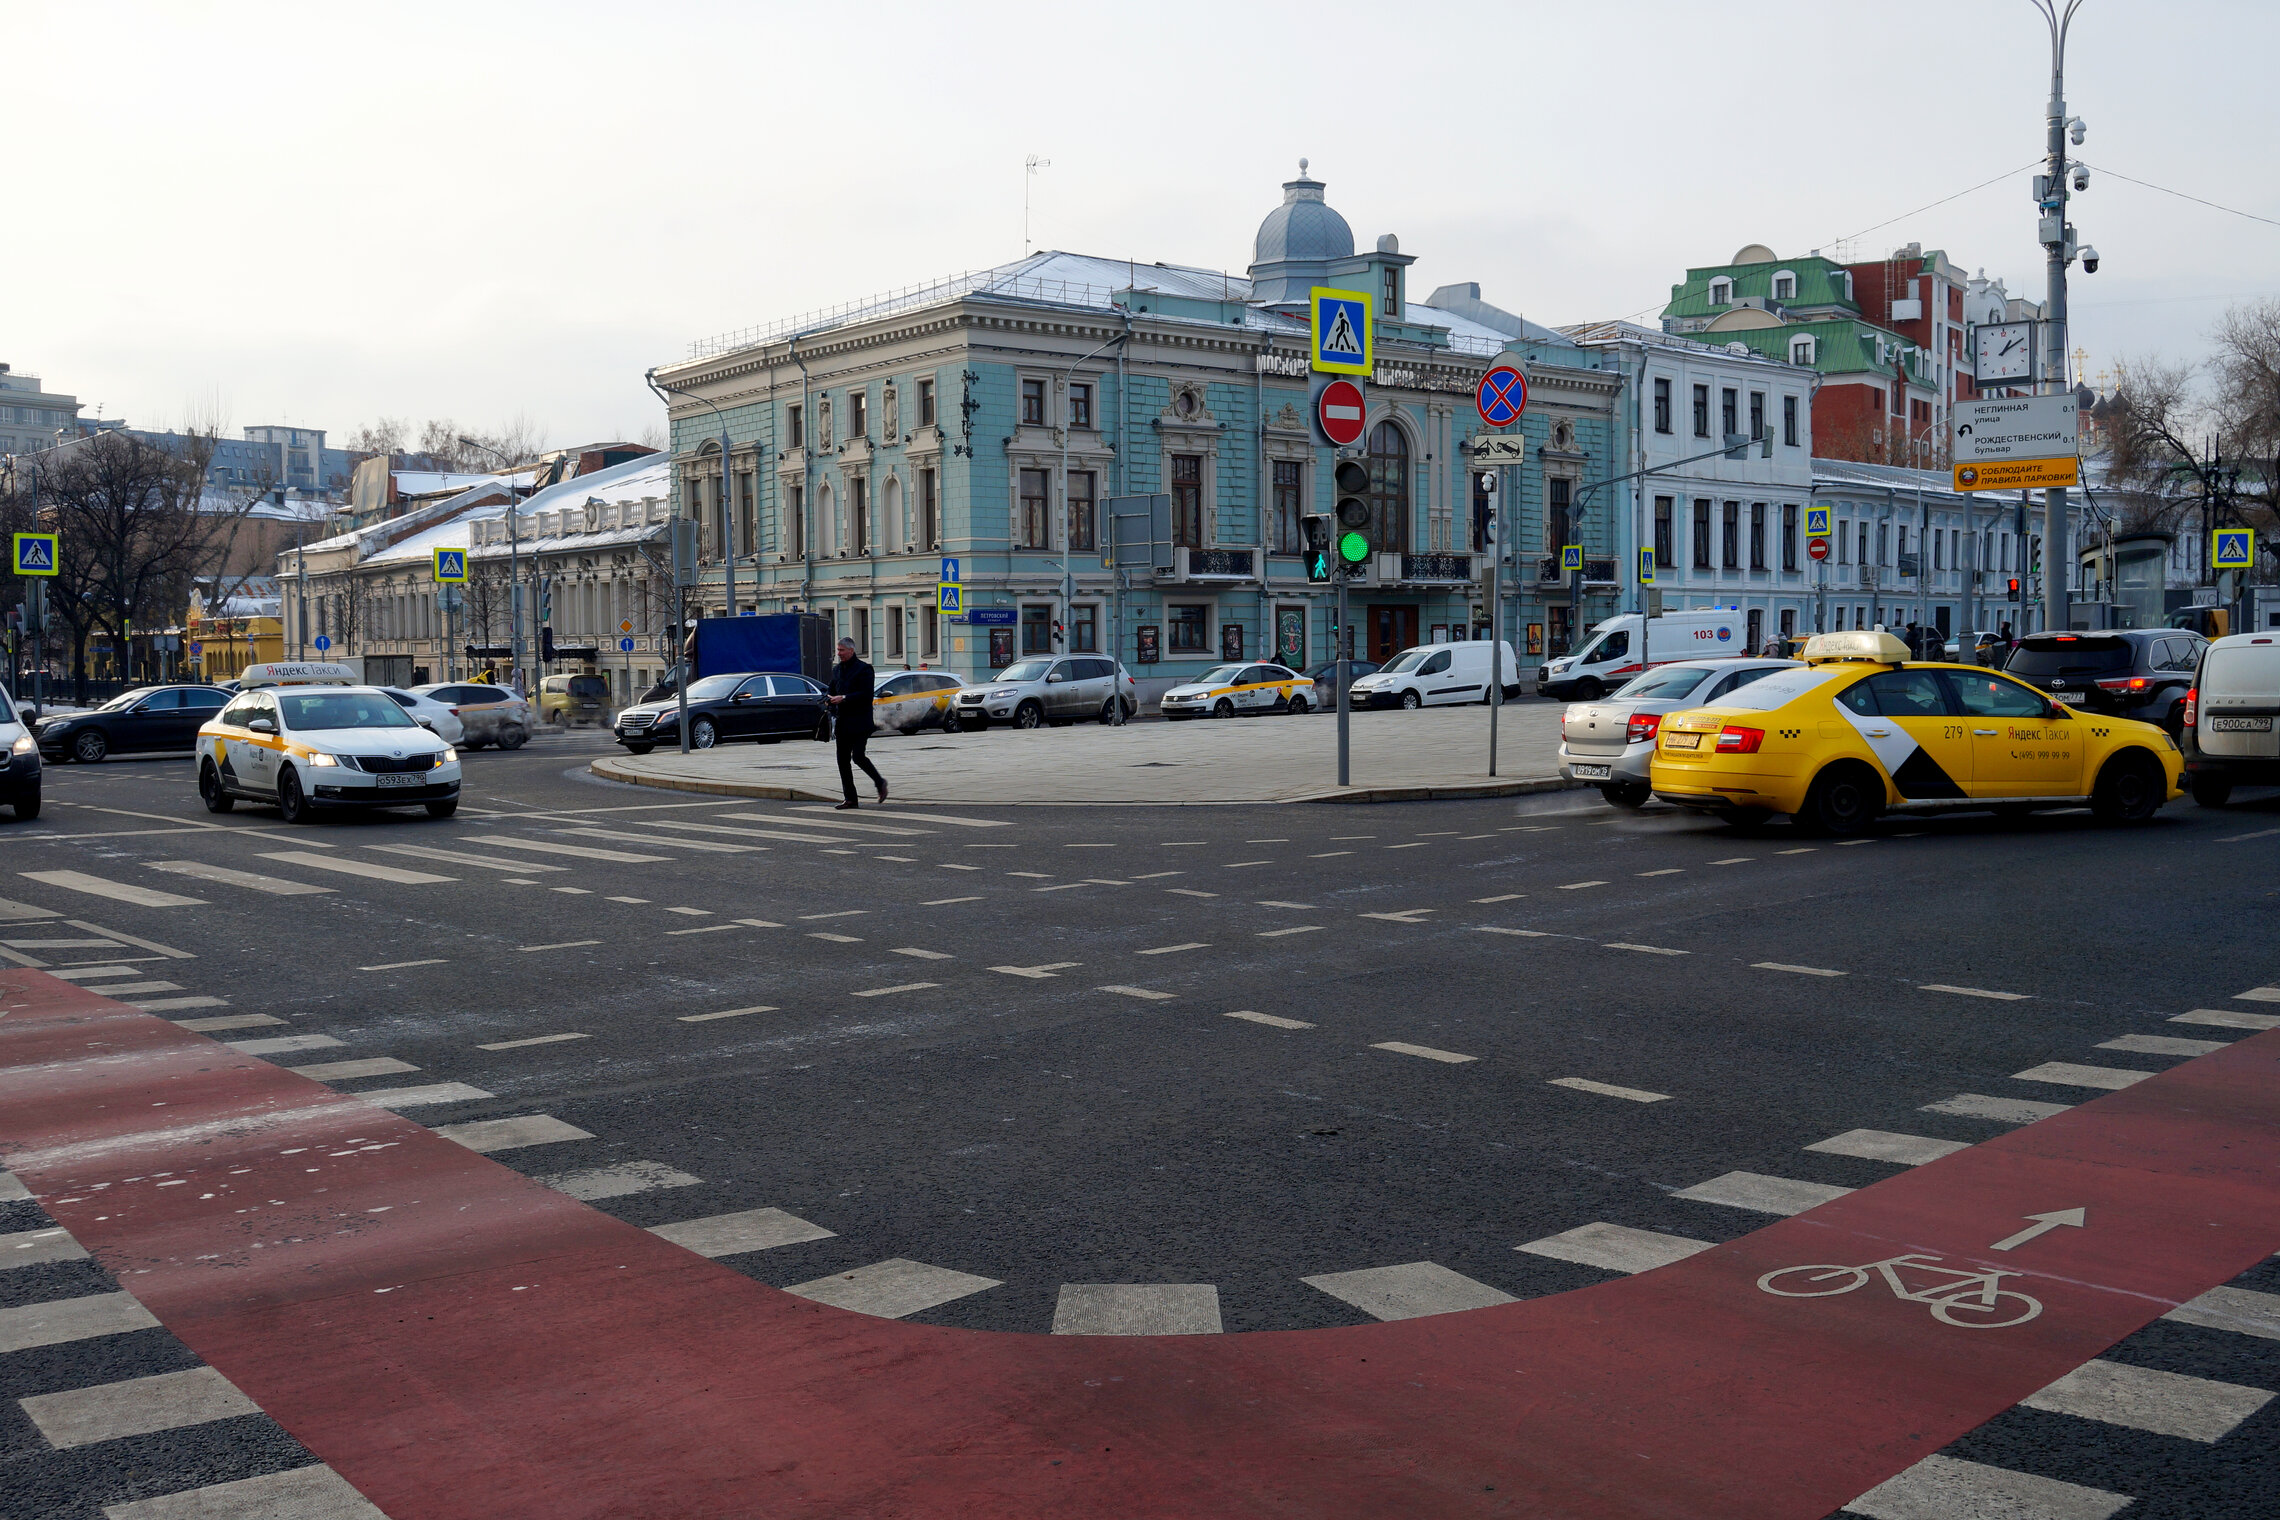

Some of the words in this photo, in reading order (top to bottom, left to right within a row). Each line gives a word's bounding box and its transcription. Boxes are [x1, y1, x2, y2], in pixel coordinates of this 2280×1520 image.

[1974, 403, 2029, 415] НЕГЛИННАЯ
[2062, 405, 2075, 413] 0.1
[1974, 415, 2001, 425] улица
[1974, 431, 2061, 445] РОЖДЕСТВЕНСКИЙ
[2062, 436, 2075, 444] 0.1
[1974, 446, 2011, 455] бульвар
[1981, 465, 2043, 475] СОБЛЮДАЙТЕ
[1981, 476, 2022, 485] ПРАВИЛА
[2024, 473, 2075, 483] ПАРКОВКИ!
[2193, 593, 2217, 606] WC
[1693, 629, 1714, 640] 103
[266, 665, 309, 677] Яндекс
[308, 664, 341, 675] Такси
[1944, 726, 1963, 739] 279
[2008, 726, 2041, 741] Яндекс
[2044, 726, 2070, 741] Такси
[2019, 751, 2035, 760] (495)
[2037, 751, 2049, 759] 999
